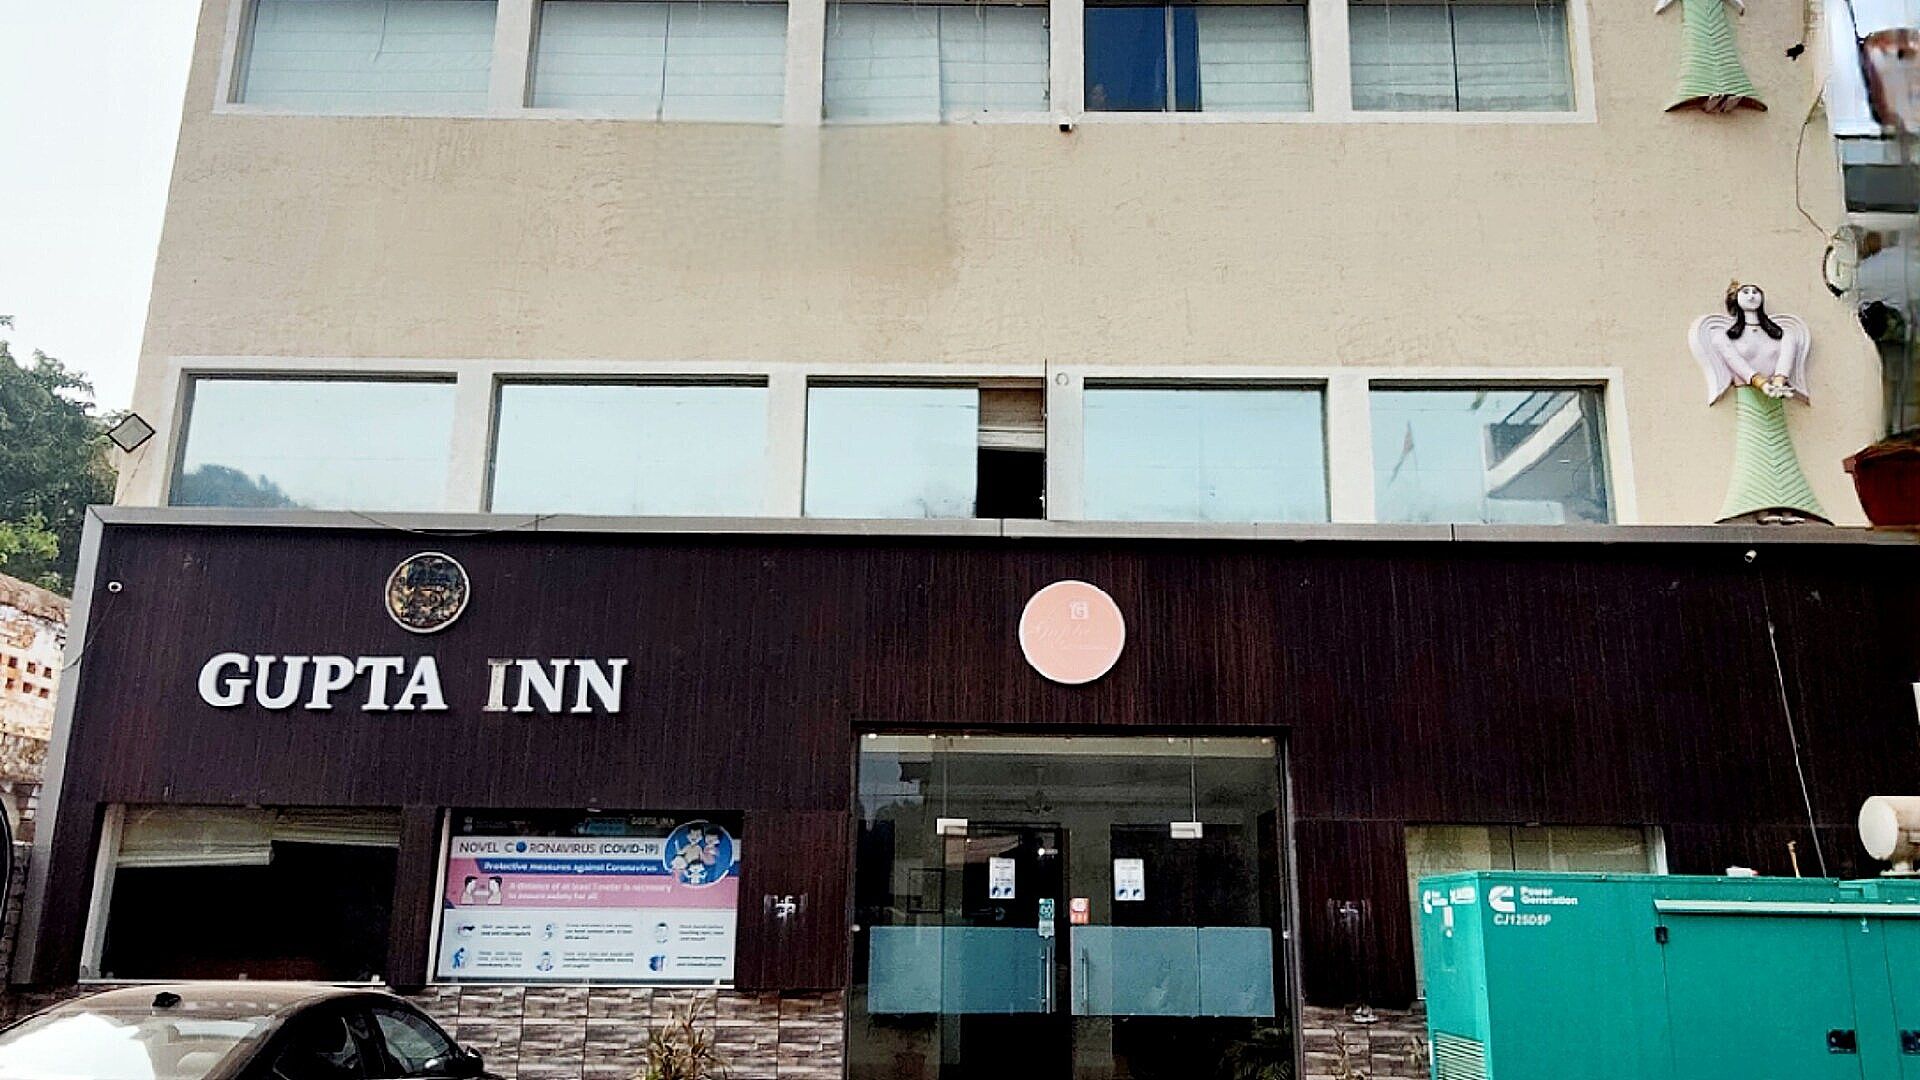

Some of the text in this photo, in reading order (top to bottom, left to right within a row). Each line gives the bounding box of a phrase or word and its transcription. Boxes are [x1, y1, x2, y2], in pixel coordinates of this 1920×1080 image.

[198, 652, 629, 714] GUPTA INN
[459, 842, 499, 853] NOVEL
[599, 843, 658, 855] (COVID-19)
[484, 861, 657, 873] Protective measures against Coronavirus
[1519, 886, 1554, 896] Power
[1520, 896, 1578, 905] Generation
